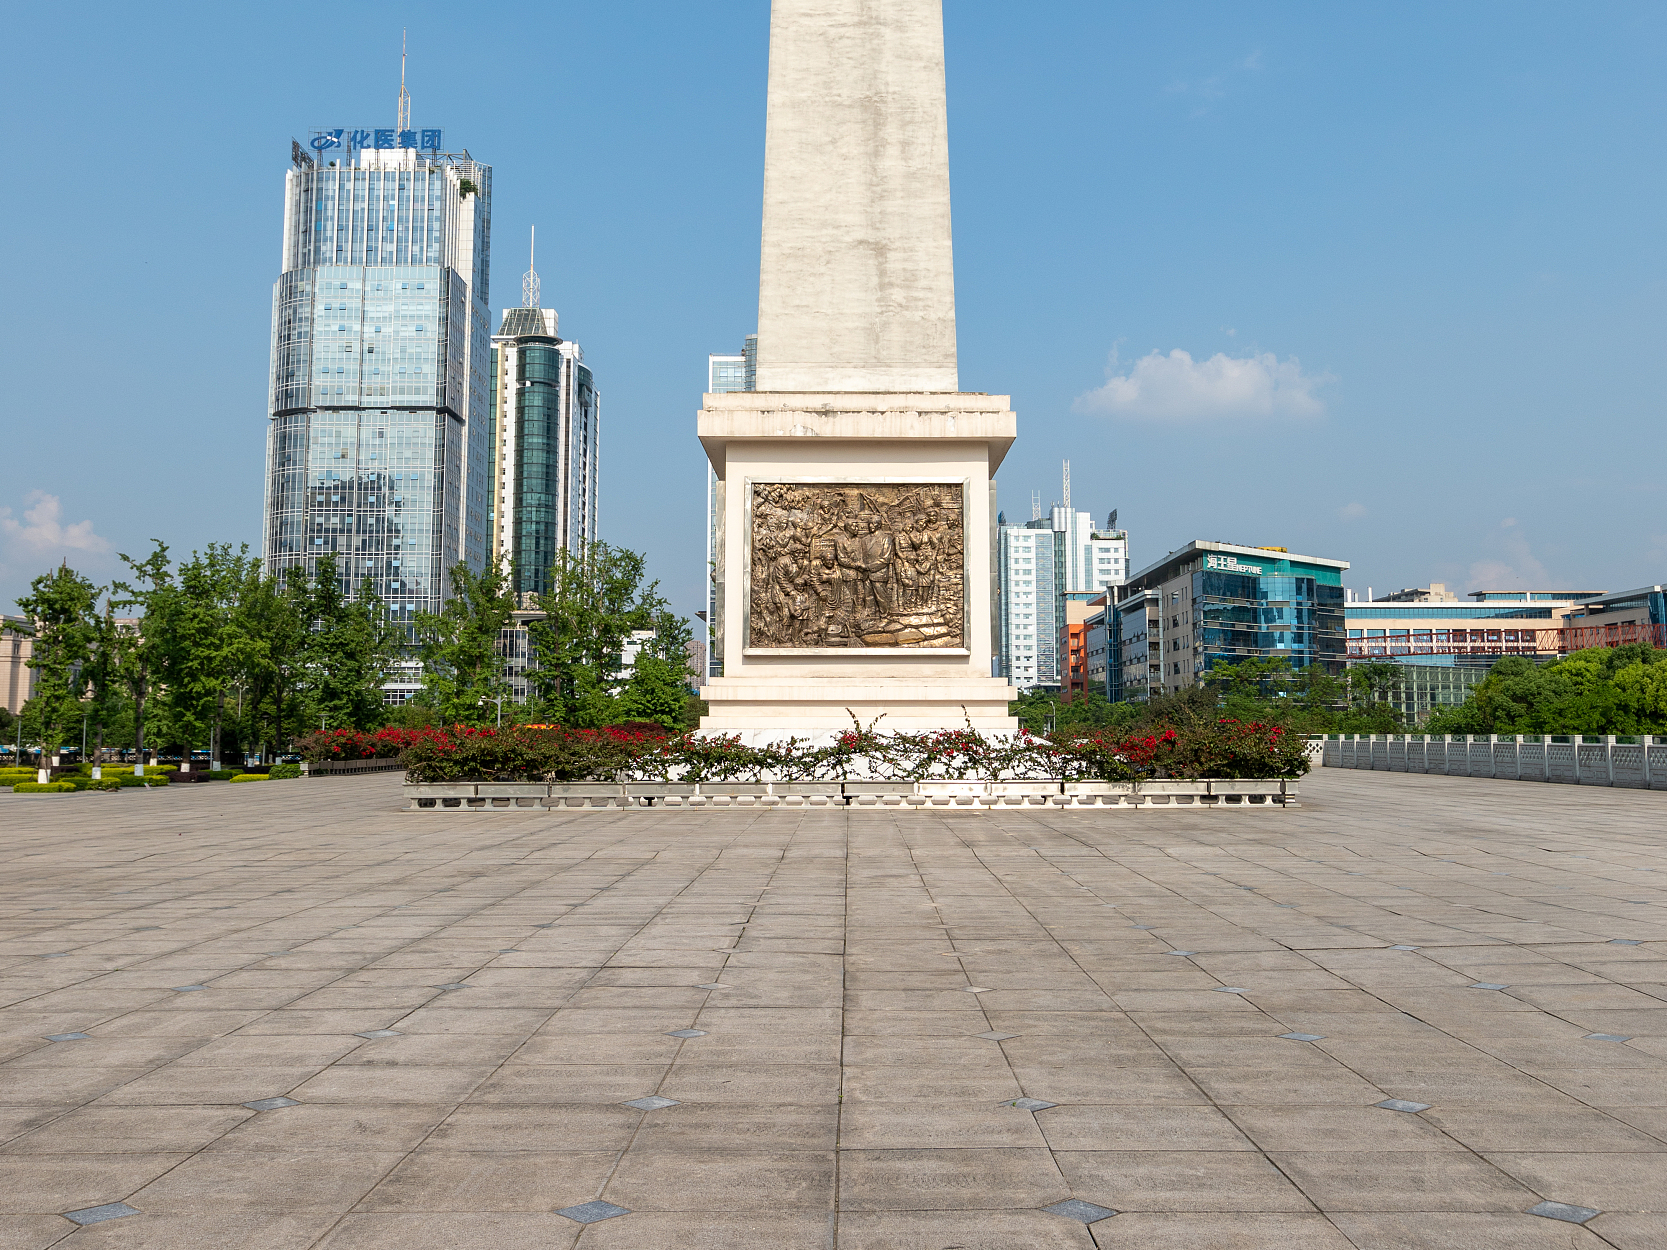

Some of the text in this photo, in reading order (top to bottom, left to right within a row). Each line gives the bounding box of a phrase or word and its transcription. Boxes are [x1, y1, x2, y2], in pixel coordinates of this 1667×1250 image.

[351, 129, 441, 150] 化医集团
[1207, 554, 1238, 571] 海王星
[1237, 564, 1262, 575] NEPTUNE
